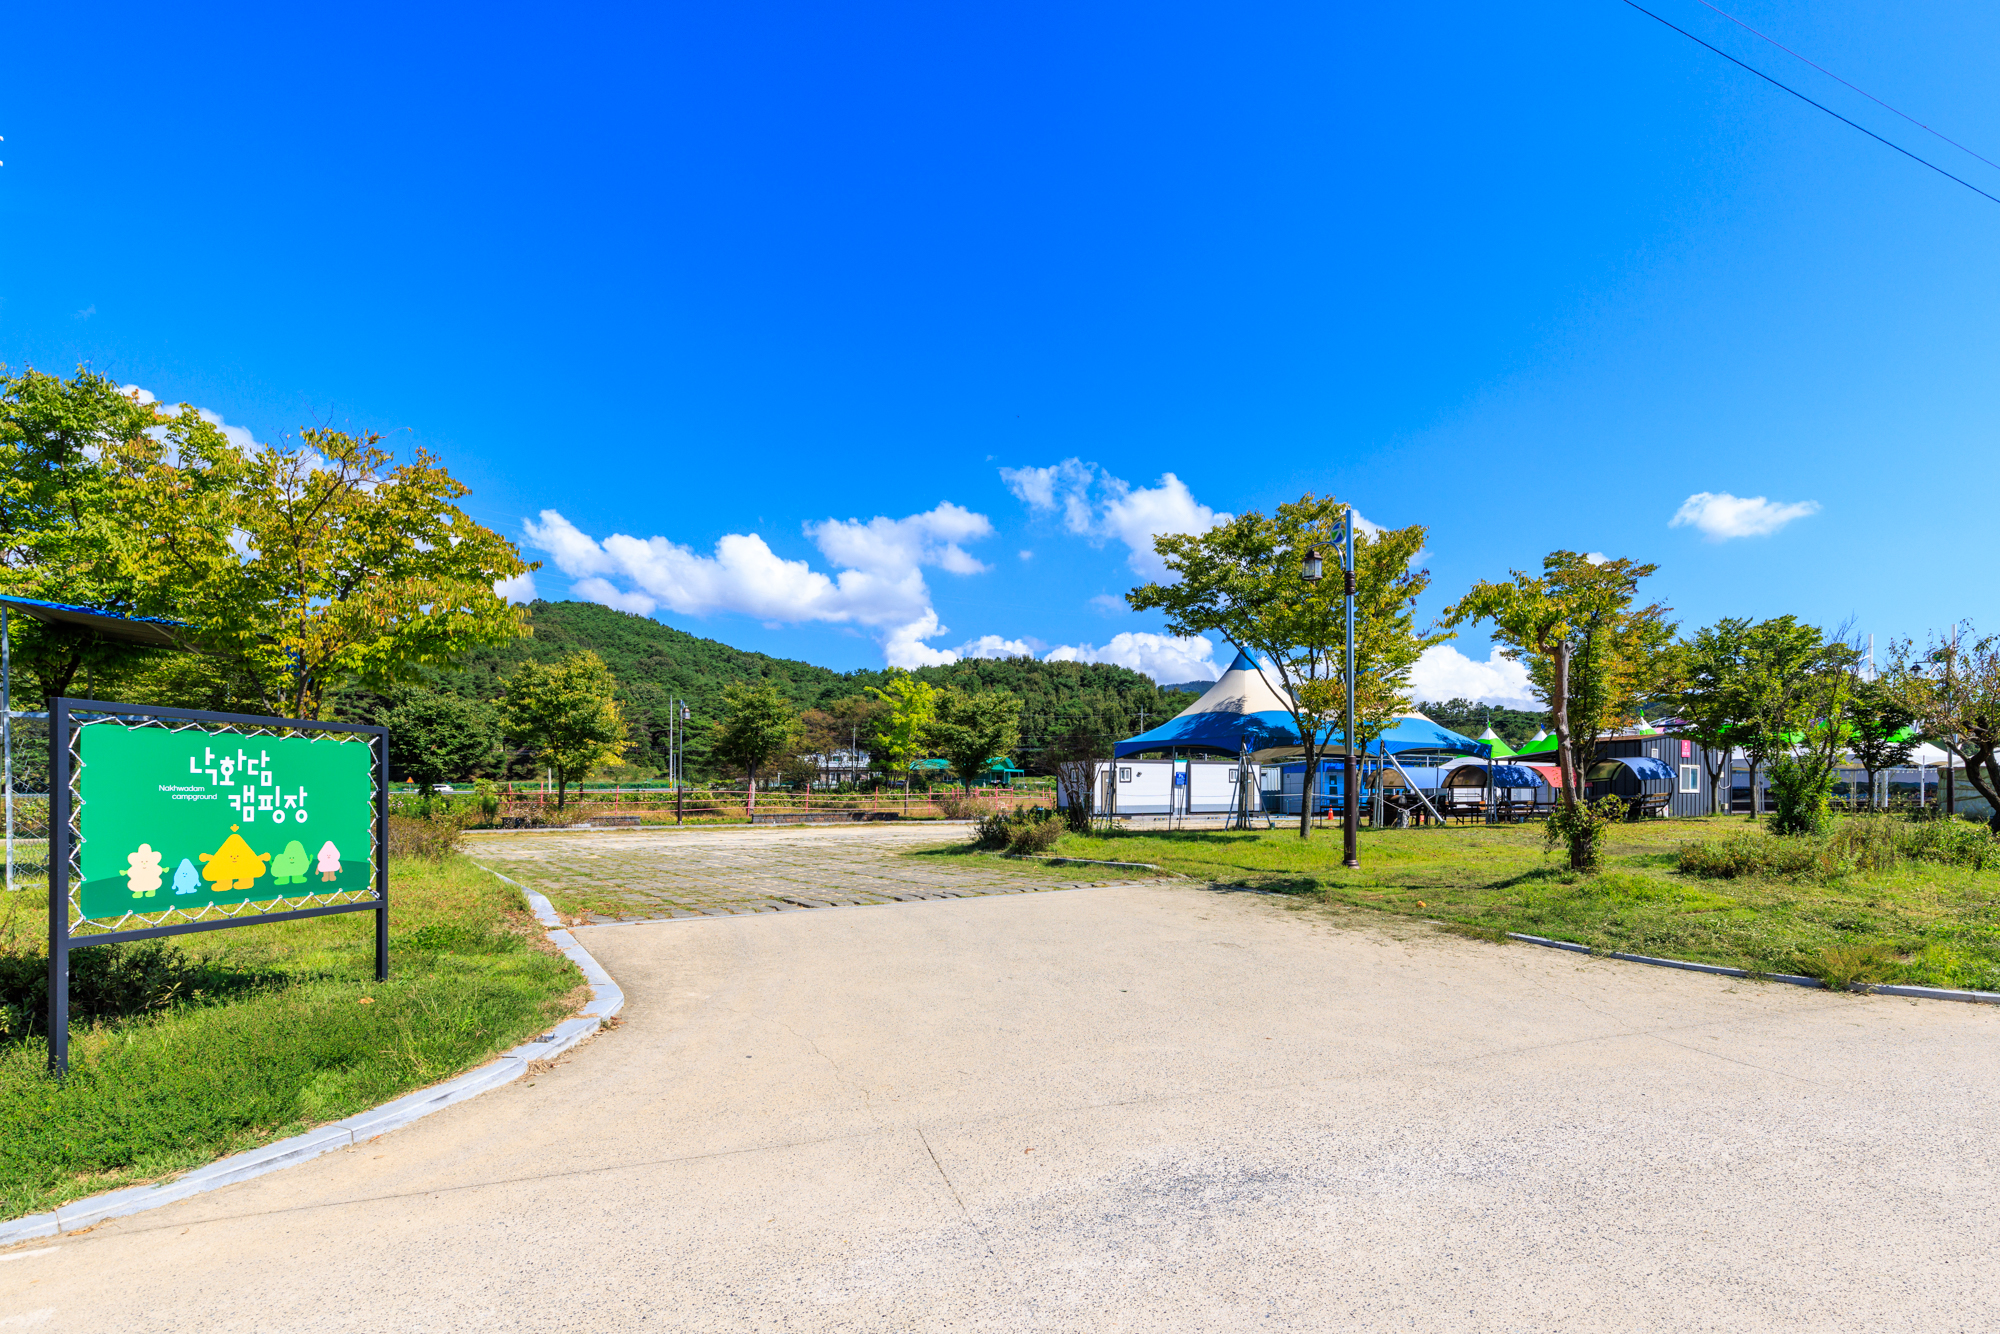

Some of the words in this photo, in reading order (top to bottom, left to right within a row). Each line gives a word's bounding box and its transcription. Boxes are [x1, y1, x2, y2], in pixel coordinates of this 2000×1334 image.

[190, 747, 272, 787] 낙화담
[171, 793, 218, 801] campground
[228, 785, 308, 824] 캠핑장
